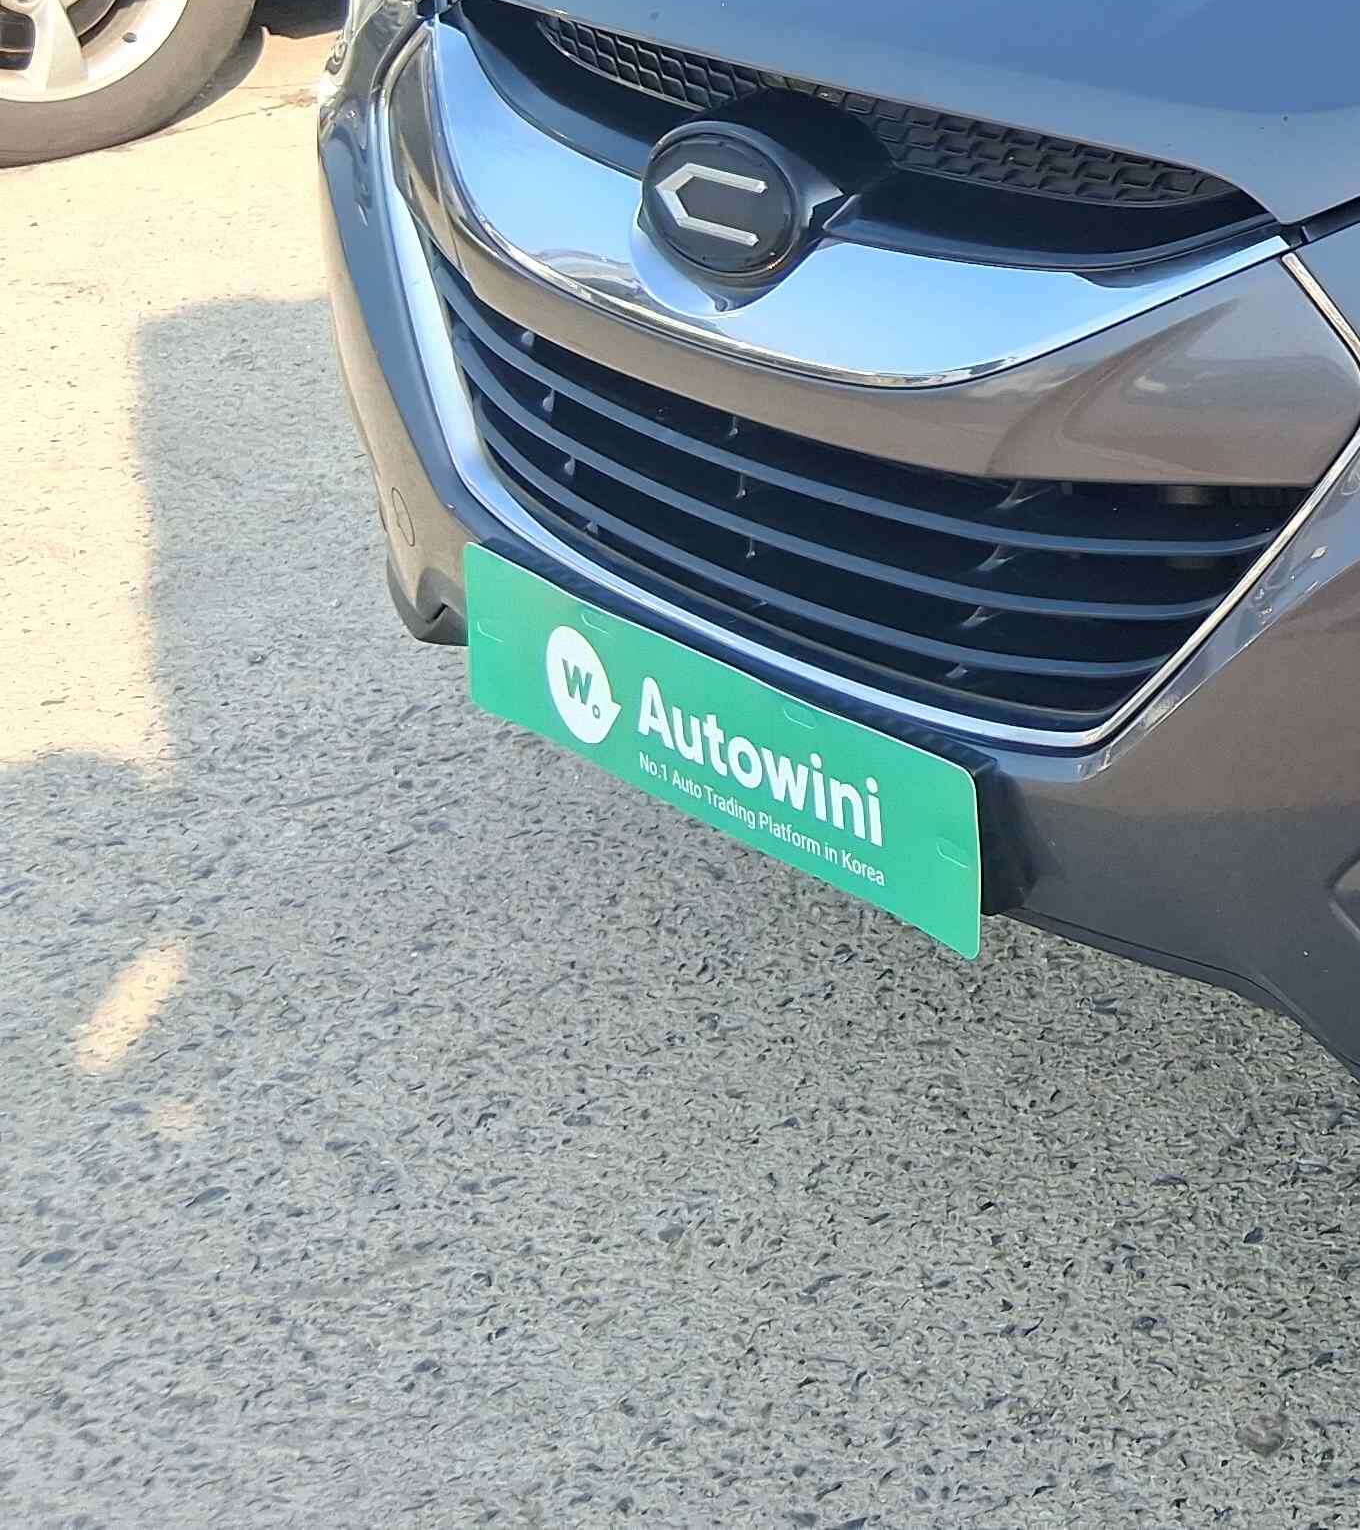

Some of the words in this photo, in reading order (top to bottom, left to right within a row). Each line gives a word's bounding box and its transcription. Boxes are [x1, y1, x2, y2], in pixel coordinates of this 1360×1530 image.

[637, 675, 884, 848] Autowini
[639, 750, 669, 783] No.1
[671, 769, 703, 799] Auto
[703, 784, 757, 830] Trading
[759, 810, 822, 857] Platform
[824, 841, 838, 865] in
[841, 849, 886, 887] Korea
